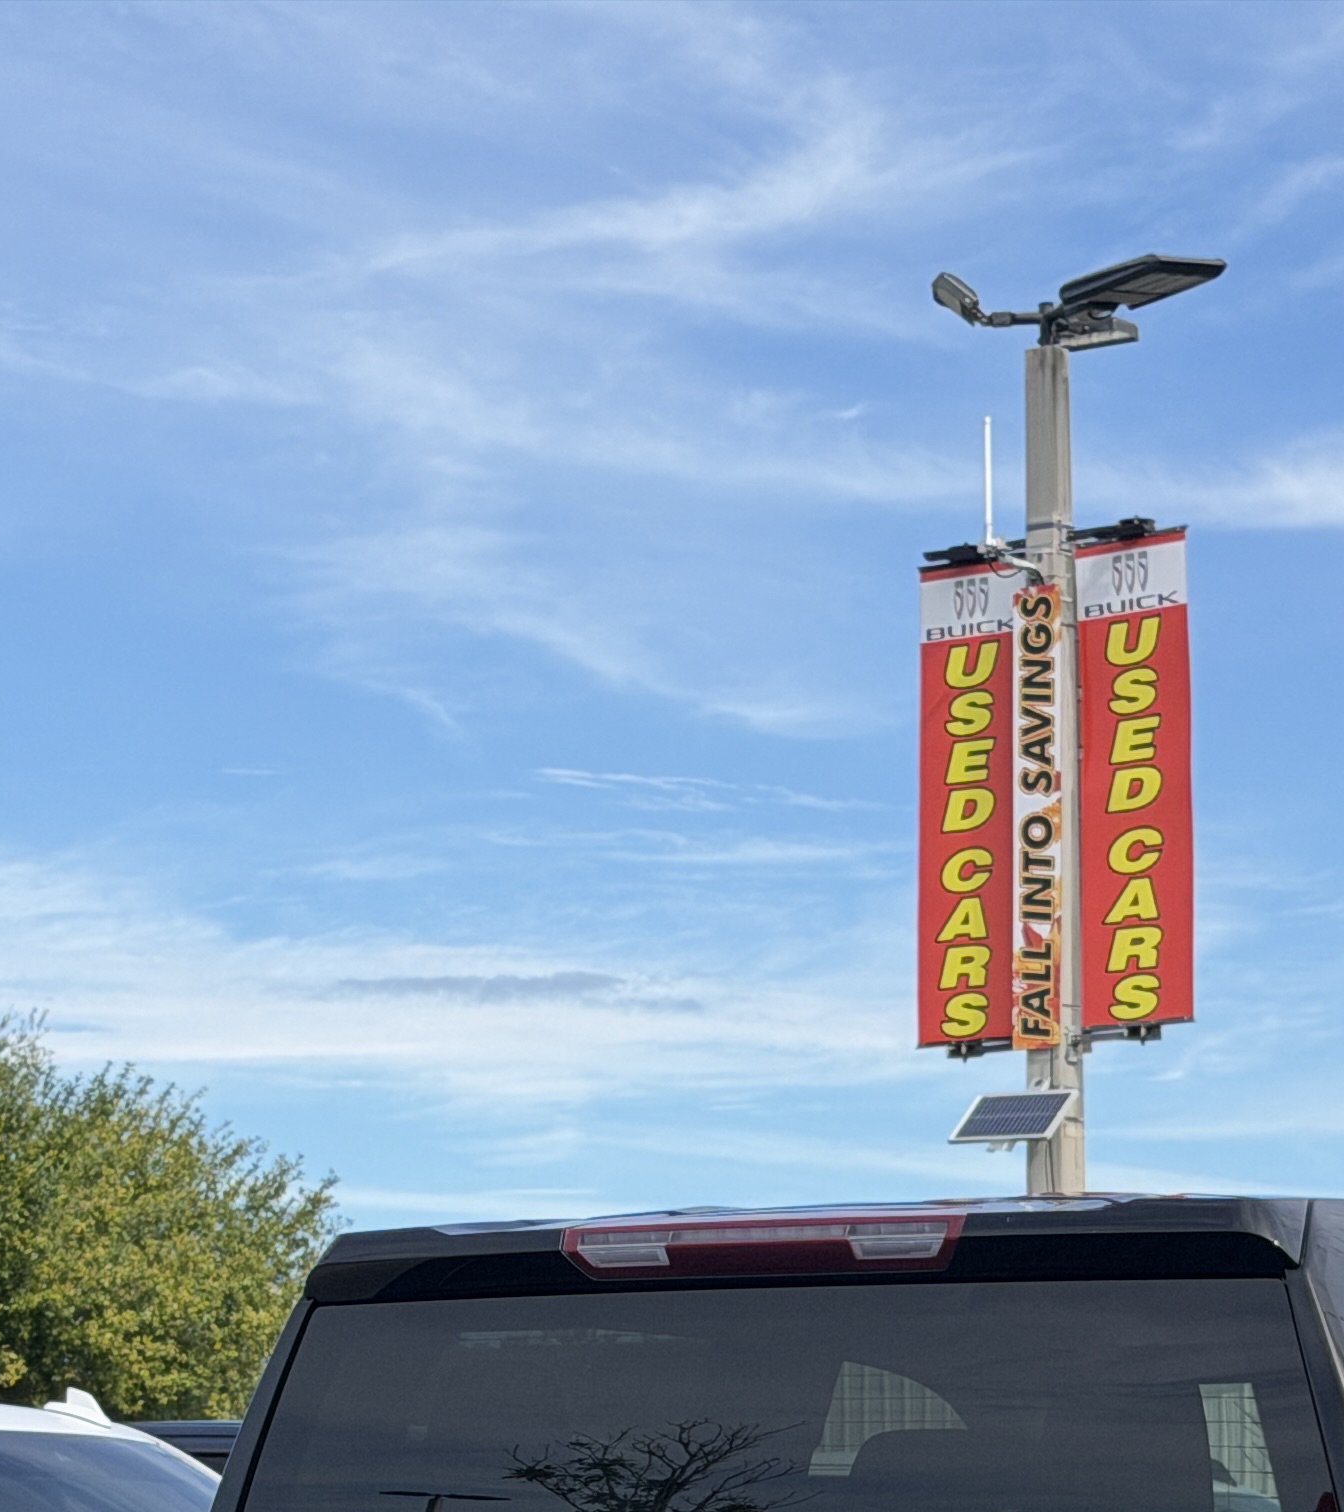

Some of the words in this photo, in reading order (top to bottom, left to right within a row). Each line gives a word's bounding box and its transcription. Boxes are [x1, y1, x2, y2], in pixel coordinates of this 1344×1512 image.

[926, 619, 1013, 642] BUICK
[1018, 594, 1055, 796] SAVINGS
[1084, 590, 1178, 618] BUICK
[940, 639, 1000, 834] USED
[1104, 613, 1162, 814] USED
[935, 847, 993, 1038] CARS
[1018, 813, 1055, 923] INTO
[1102, 825, 1164, 1021] CARS
[1018, 939, 1056, 1039] FALL
